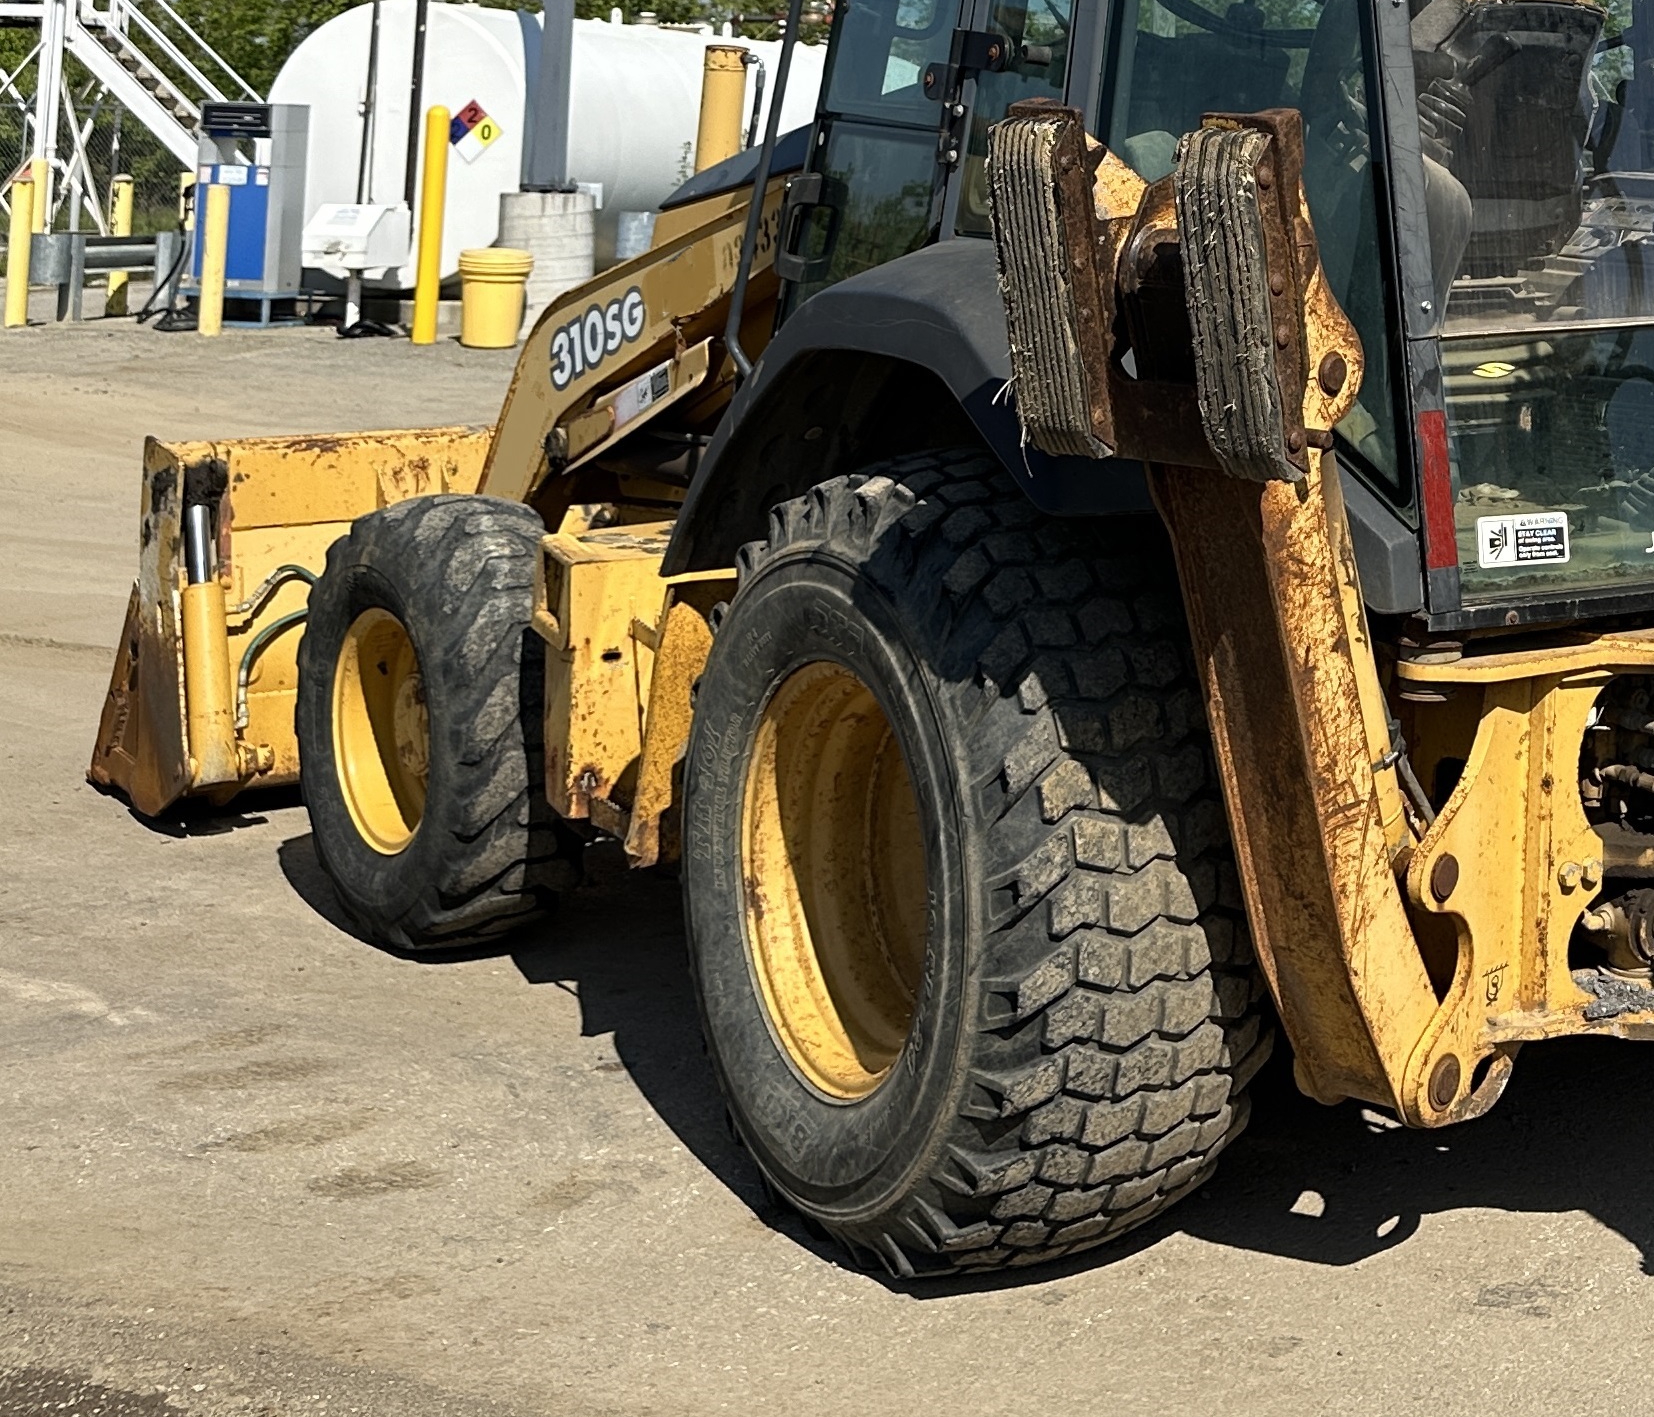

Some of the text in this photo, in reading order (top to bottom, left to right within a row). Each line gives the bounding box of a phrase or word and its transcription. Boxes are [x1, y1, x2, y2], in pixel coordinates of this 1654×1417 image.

[467, 107, 479, 123] 2
[481, 124, 491, 140] 0
[551, 289, 645, 387] 310SG
[1535, 528, 1557, 537] CLEAR
